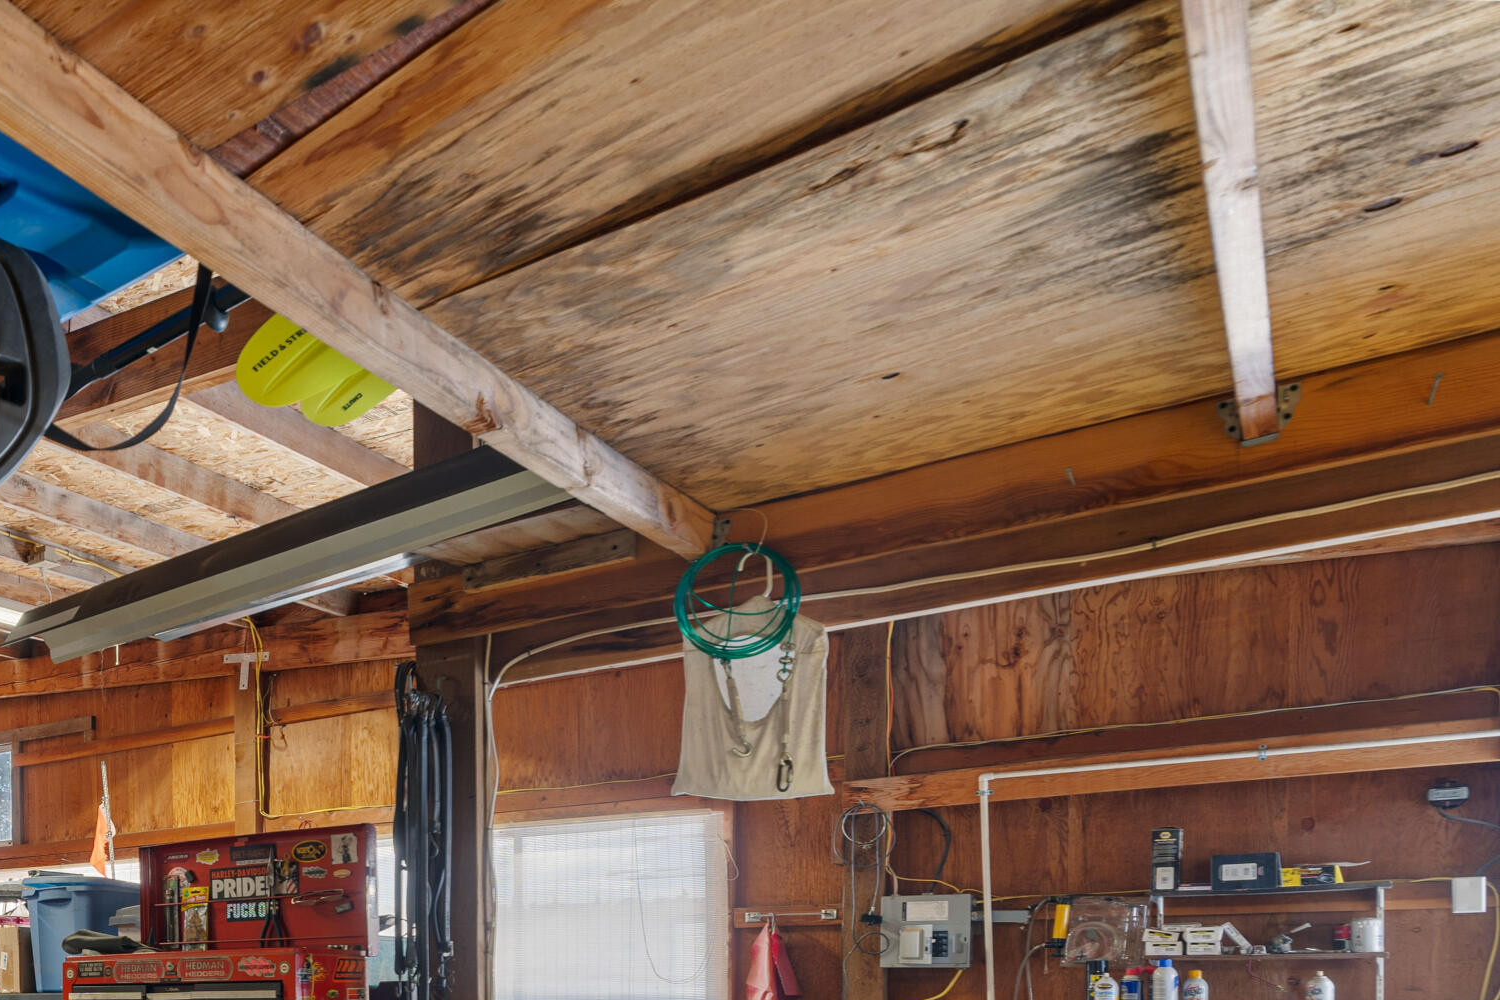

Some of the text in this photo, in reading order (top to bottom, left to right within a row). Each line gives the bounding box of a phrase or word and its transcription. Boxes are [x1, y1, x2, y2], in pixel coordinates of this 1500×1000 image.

[252, 350, 279, 372] FIELD
[211, 867, 269, 879] HARLEY-DAVIDSO
[226, 902, 270, 919] FUCK O
[121, 964, 157, 973] HEDMAN
[185, 961, 224, 970] HEDMAN
